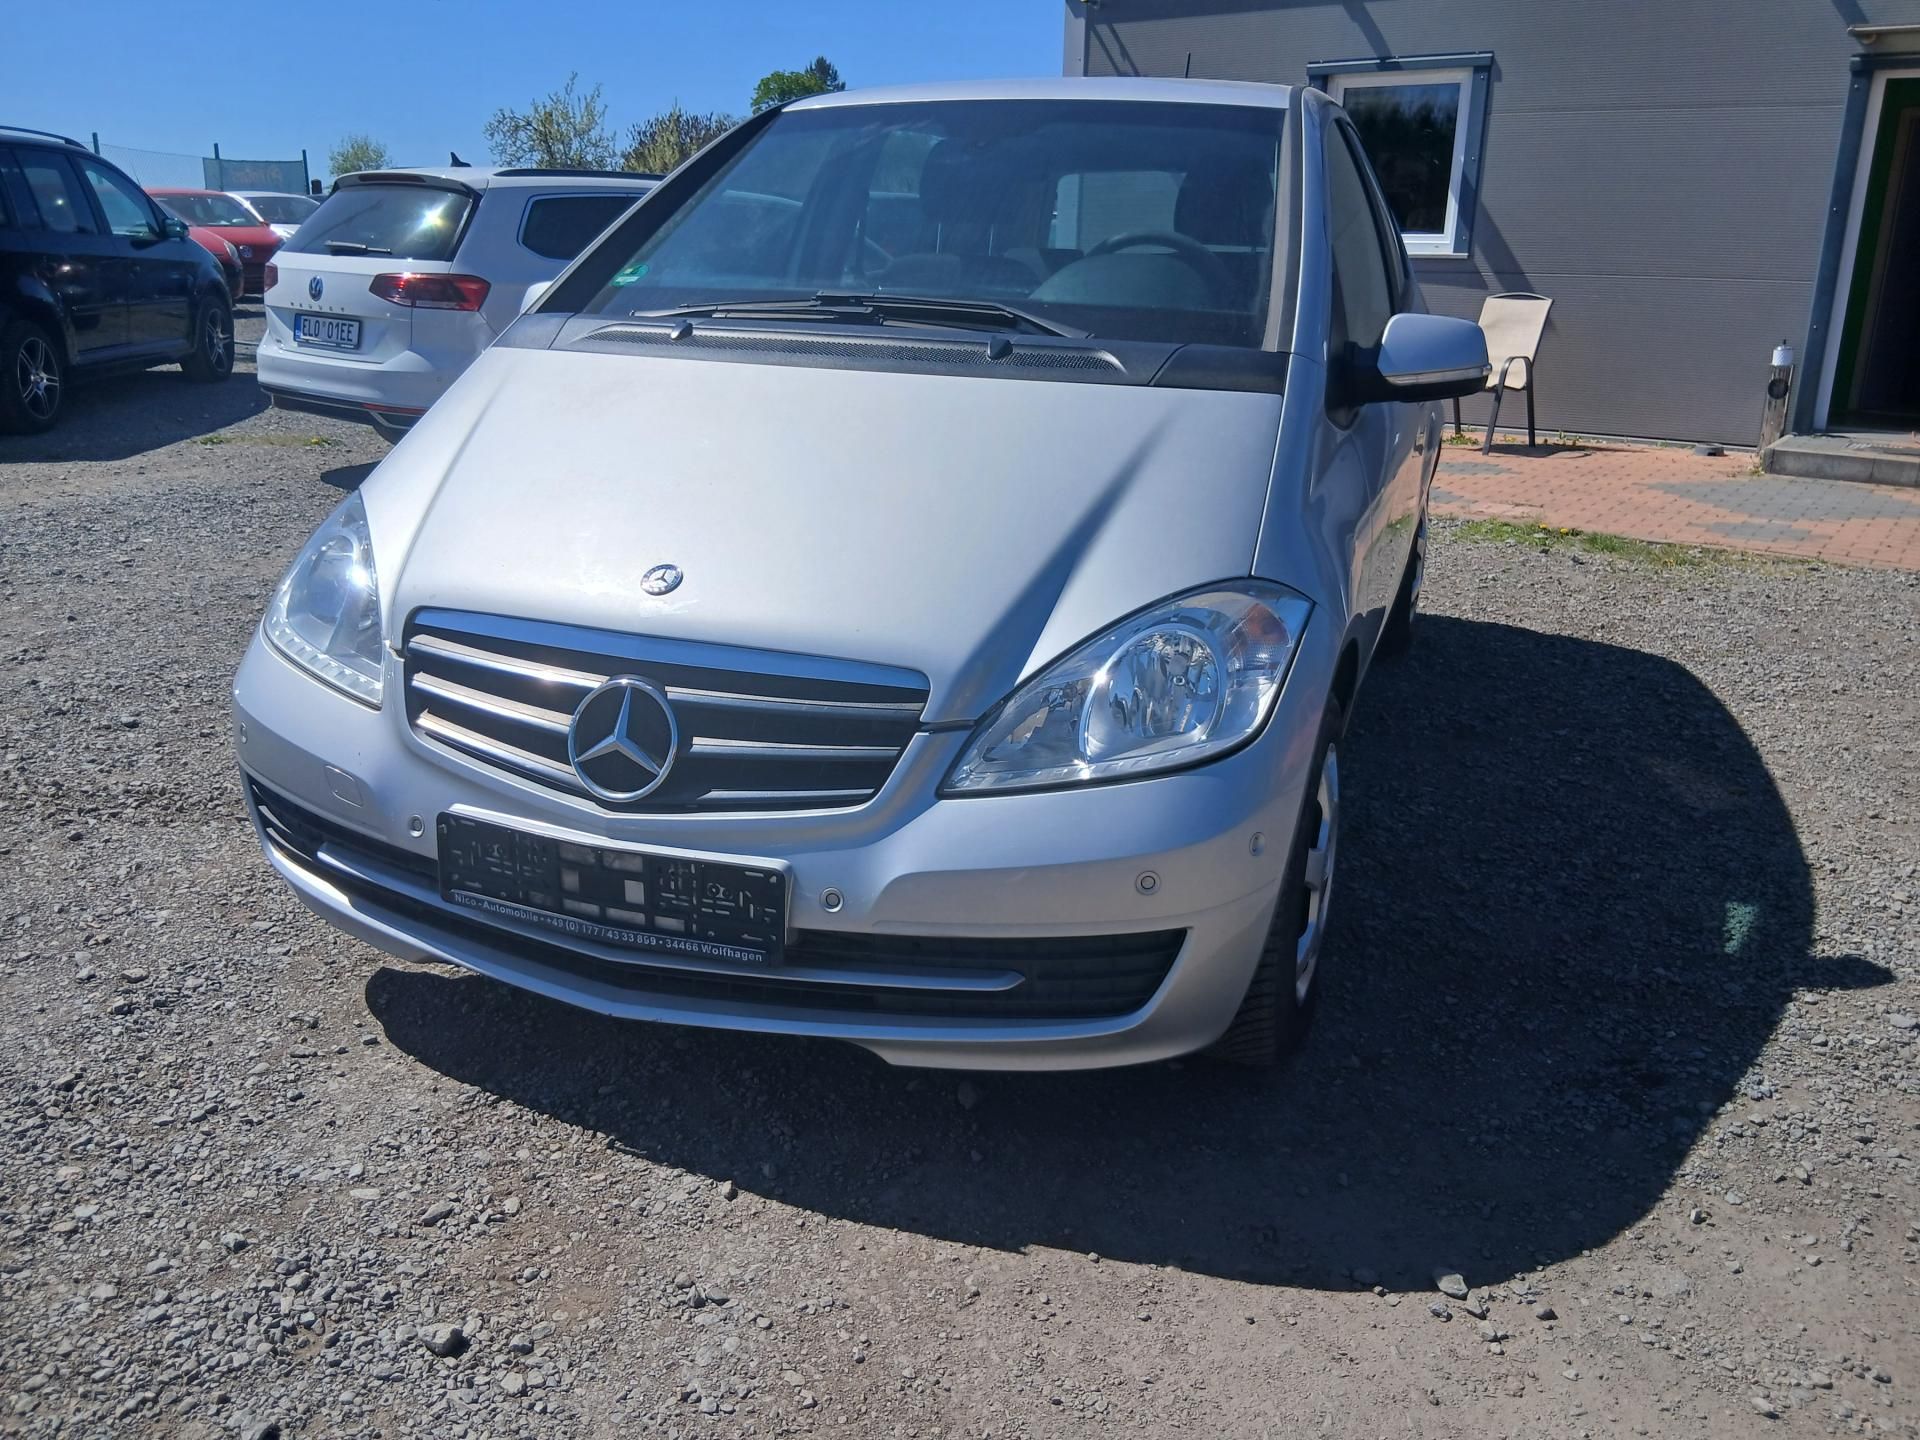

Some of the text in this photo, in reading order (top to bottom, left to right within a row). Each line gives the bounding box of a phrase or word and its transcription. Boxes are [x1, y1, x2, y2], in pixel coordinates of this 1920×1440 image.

[582, 925, 599, 936] 177
[665, 939, 699, 952] 34466
[701, 944, 762, 962] Wolfhagen
